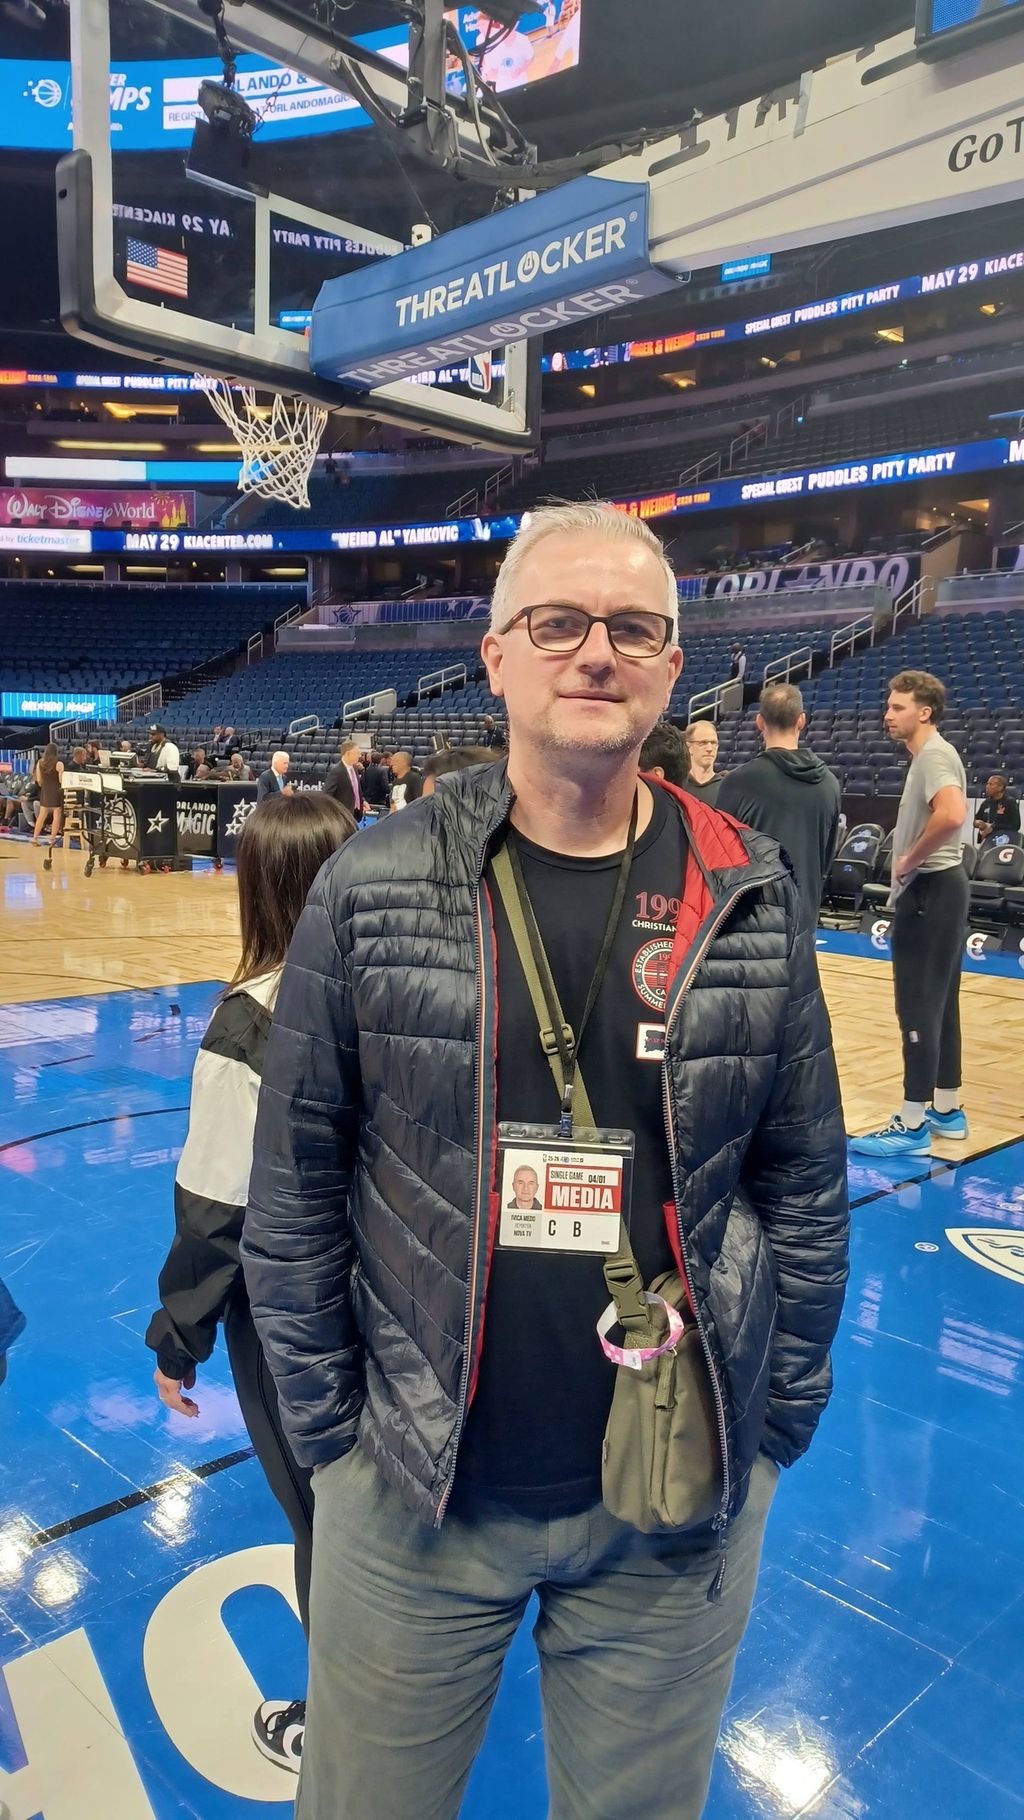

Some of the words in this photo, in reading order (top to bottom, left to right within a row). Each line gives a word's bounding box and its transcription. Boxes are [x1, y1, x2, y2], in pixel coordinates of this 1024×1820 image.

[957, 263, 979, 284] 29
[794, 301, 838, 323] PUDDLES
[841, 293, 866, 311] PITY
[866, 284, 901, 305] PARTY
[741, 480, 776, 500] SPECIAL
[776, 476, 804, 494] GUEST
[808, 465, 868, 490] PUDDLES
[871, 459, 907, 480] PITY
[908, 451, 956, 475] PARTY
[113, 502, 156, 519] World
[16, 533, 82, 545] ticketmaster
[160, 534, 180, 550] 29
[183, 534, 274, 550] KIACENTER.COM
[402, 525, 459, 546] YANKOVIC
[176, 801, 217, 812] ORLANDO
[551, 1185, 614, 1210] MEDIA
[548, 1219, 557, 1237] C
[572, 1220, 582, 1238] B
